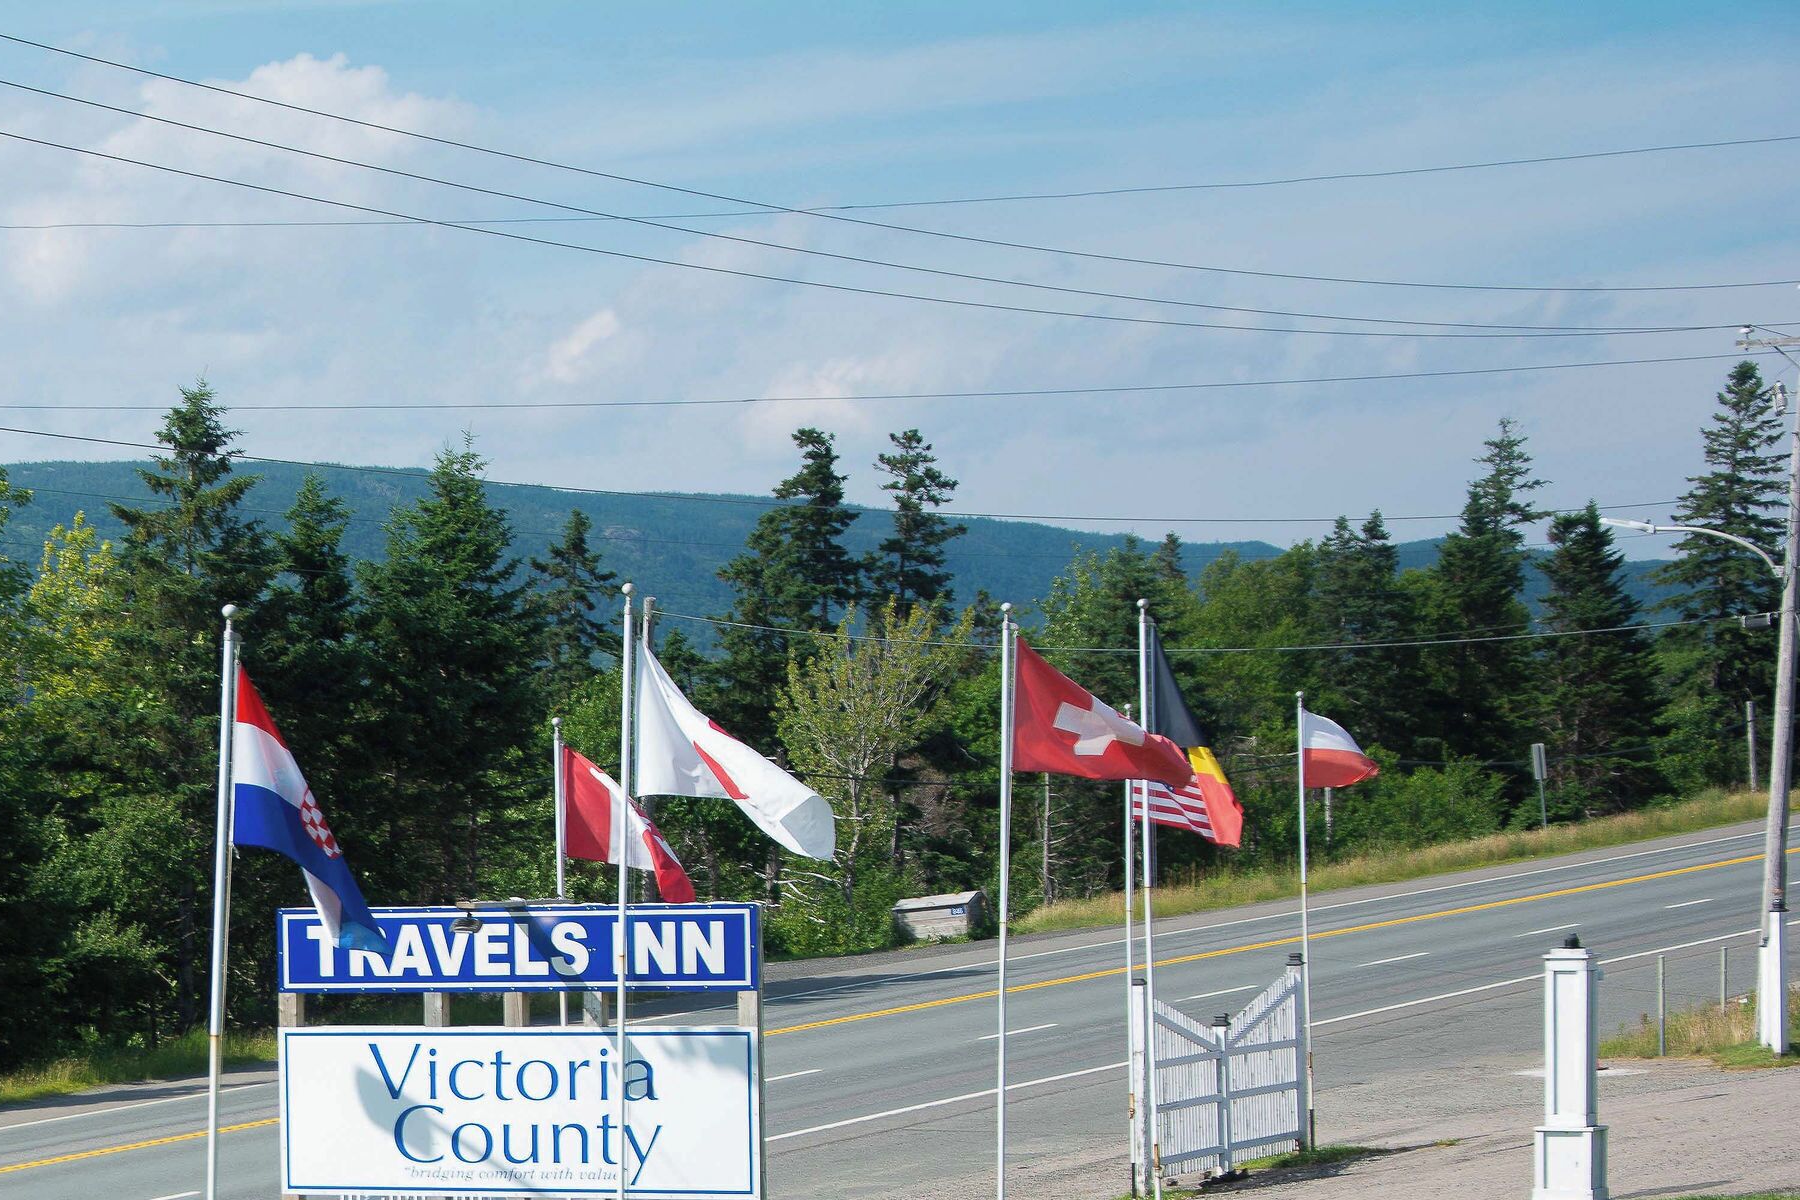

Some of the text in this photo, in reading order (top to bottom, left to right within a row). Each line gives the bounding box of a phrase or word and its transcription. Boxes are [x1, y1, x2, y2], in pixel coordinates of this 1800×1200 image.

[612, 920, 725, 975] INN
[368, 1042, 659, 1102] Victoria
[393, 1104, 663, 1186] County
[479, 1167, 535, 1182] comfort
[540, 1167, 574, 1181] with
